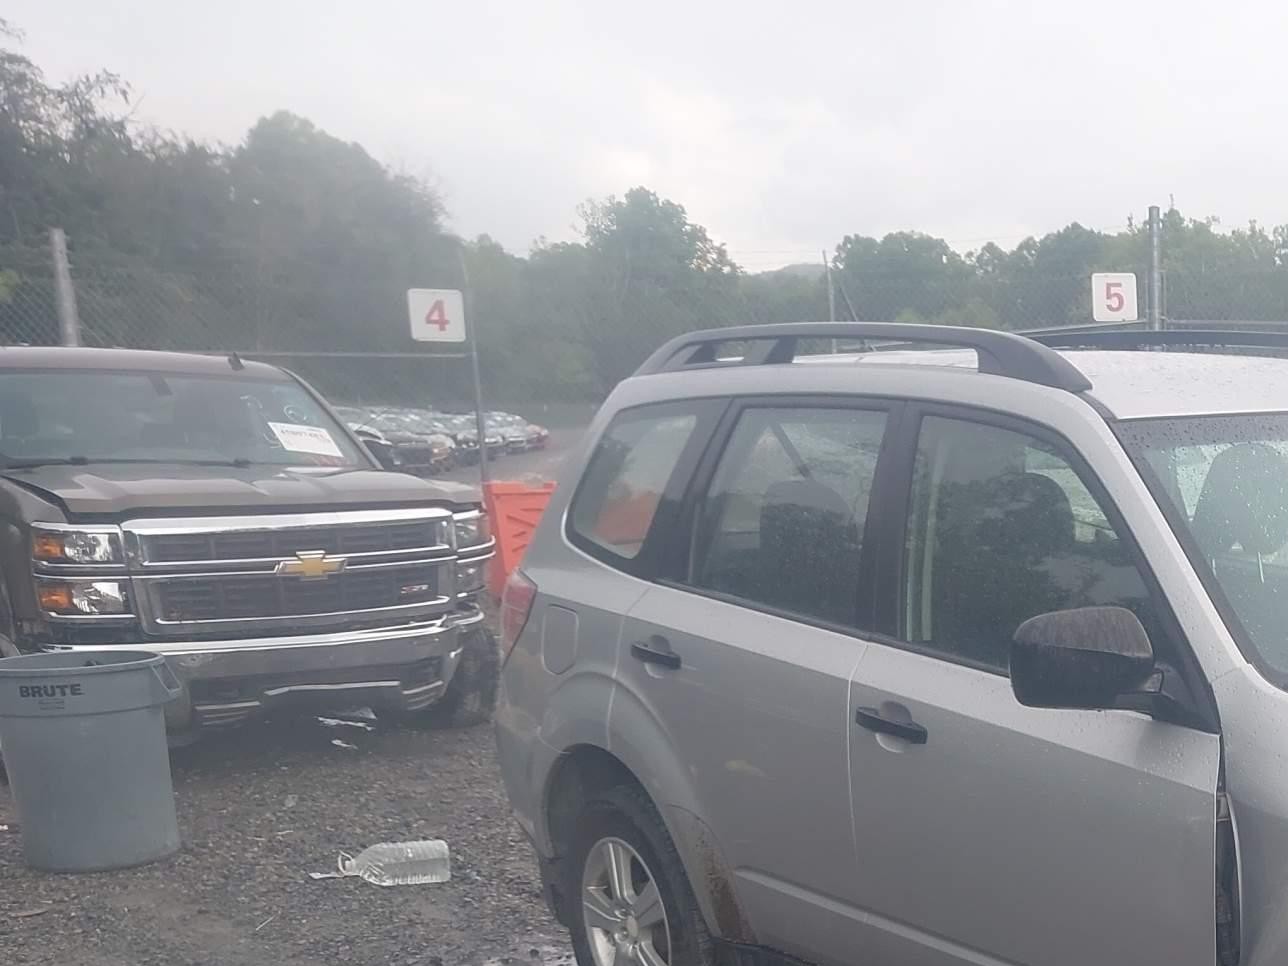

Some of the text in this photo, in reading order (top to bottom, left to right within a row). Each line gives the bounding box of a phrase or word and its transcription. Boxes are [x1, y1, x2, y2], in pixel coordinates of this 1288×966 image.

[1105, 282, 1125, 312] 5
[424, 299, 450, 332] 4
[19, 684, 85, 698] BRUTE
